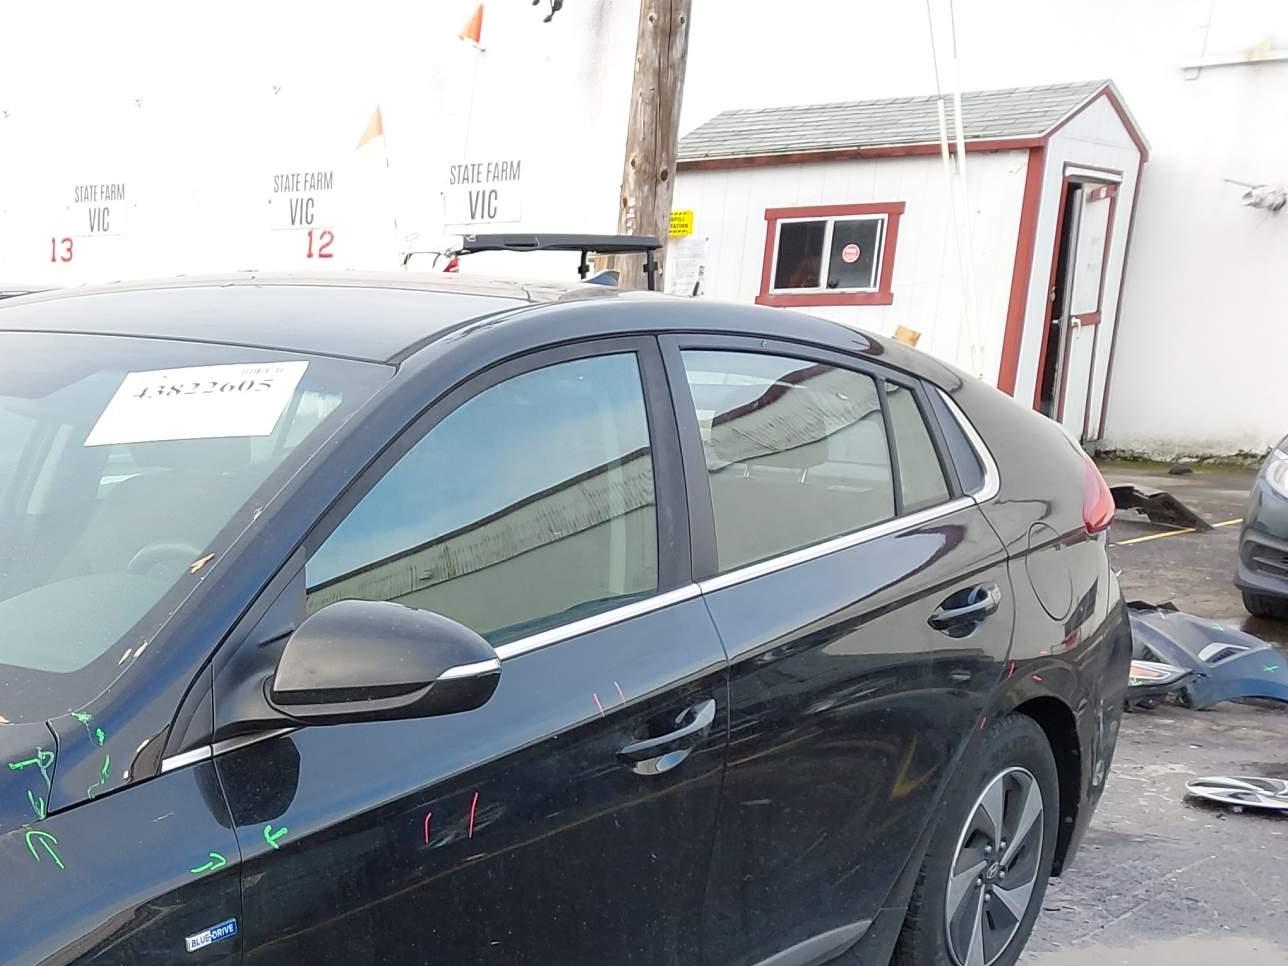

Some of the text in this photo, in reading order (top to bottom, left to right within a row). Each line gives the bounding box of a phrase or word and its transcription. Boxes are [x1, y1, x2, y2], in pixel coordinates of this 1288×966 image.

[273, 171, 333, 193] STATE FARM
[450, 160, 521, 185] STATE FARM
[75, 183, 125, 203] STATE FARM
[469, 189, 498, 220] VIC
[88, 207, 110, 233] VIC
[289, 198, 315, 226] VIC
[50, 237, 74, 263] 13
[306, 229, 334, 259] 12
[133, 379, 273, 399] 43822605
